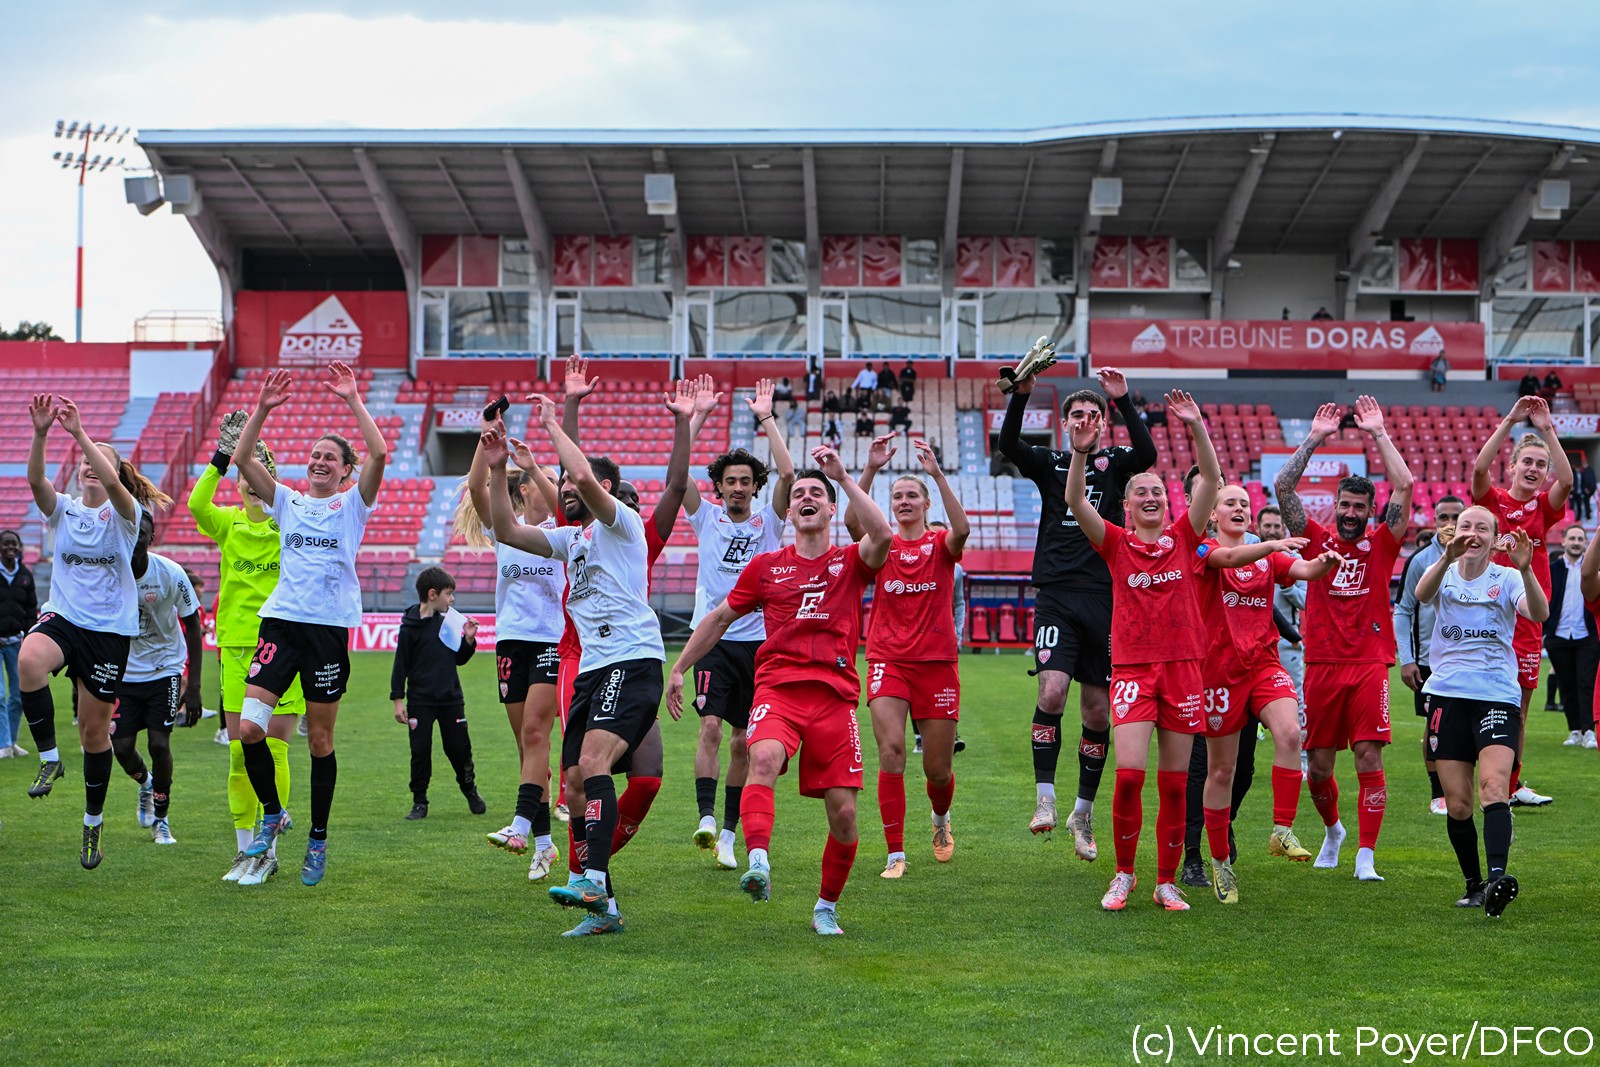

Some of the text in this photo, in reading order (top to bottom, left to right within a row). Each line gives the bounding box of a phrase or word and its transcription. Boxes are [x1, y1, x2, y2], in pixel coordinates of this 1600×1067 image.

[281, 335, 363, 353] DORAS
[1169, 326, 1406, 350] TRIBUNE DORAS
[992, 413, 1049, 428] DAS
[1552, 416, 1598, 432] ORAS
[305, 536, 339, 549] suez
[522, 566, 554, 576] suez
[1152, 569, 1183, 584] suez
[905, 581, 937, 593] suez
[1239, 596, 1267, 608] suez
[1035, 625, 1059, 649] 40
[1464, 628, 1498, 639] suez
[873, 663, 886, 680] 5
[601, 668, 621, 713] CHOPARD
[697, 670, 711, 694] 11
[1112, 680, 1140, 706] 28
[1203, 686, 1230, 714] 33
[849, 709, 863, 763] CHOPARD
